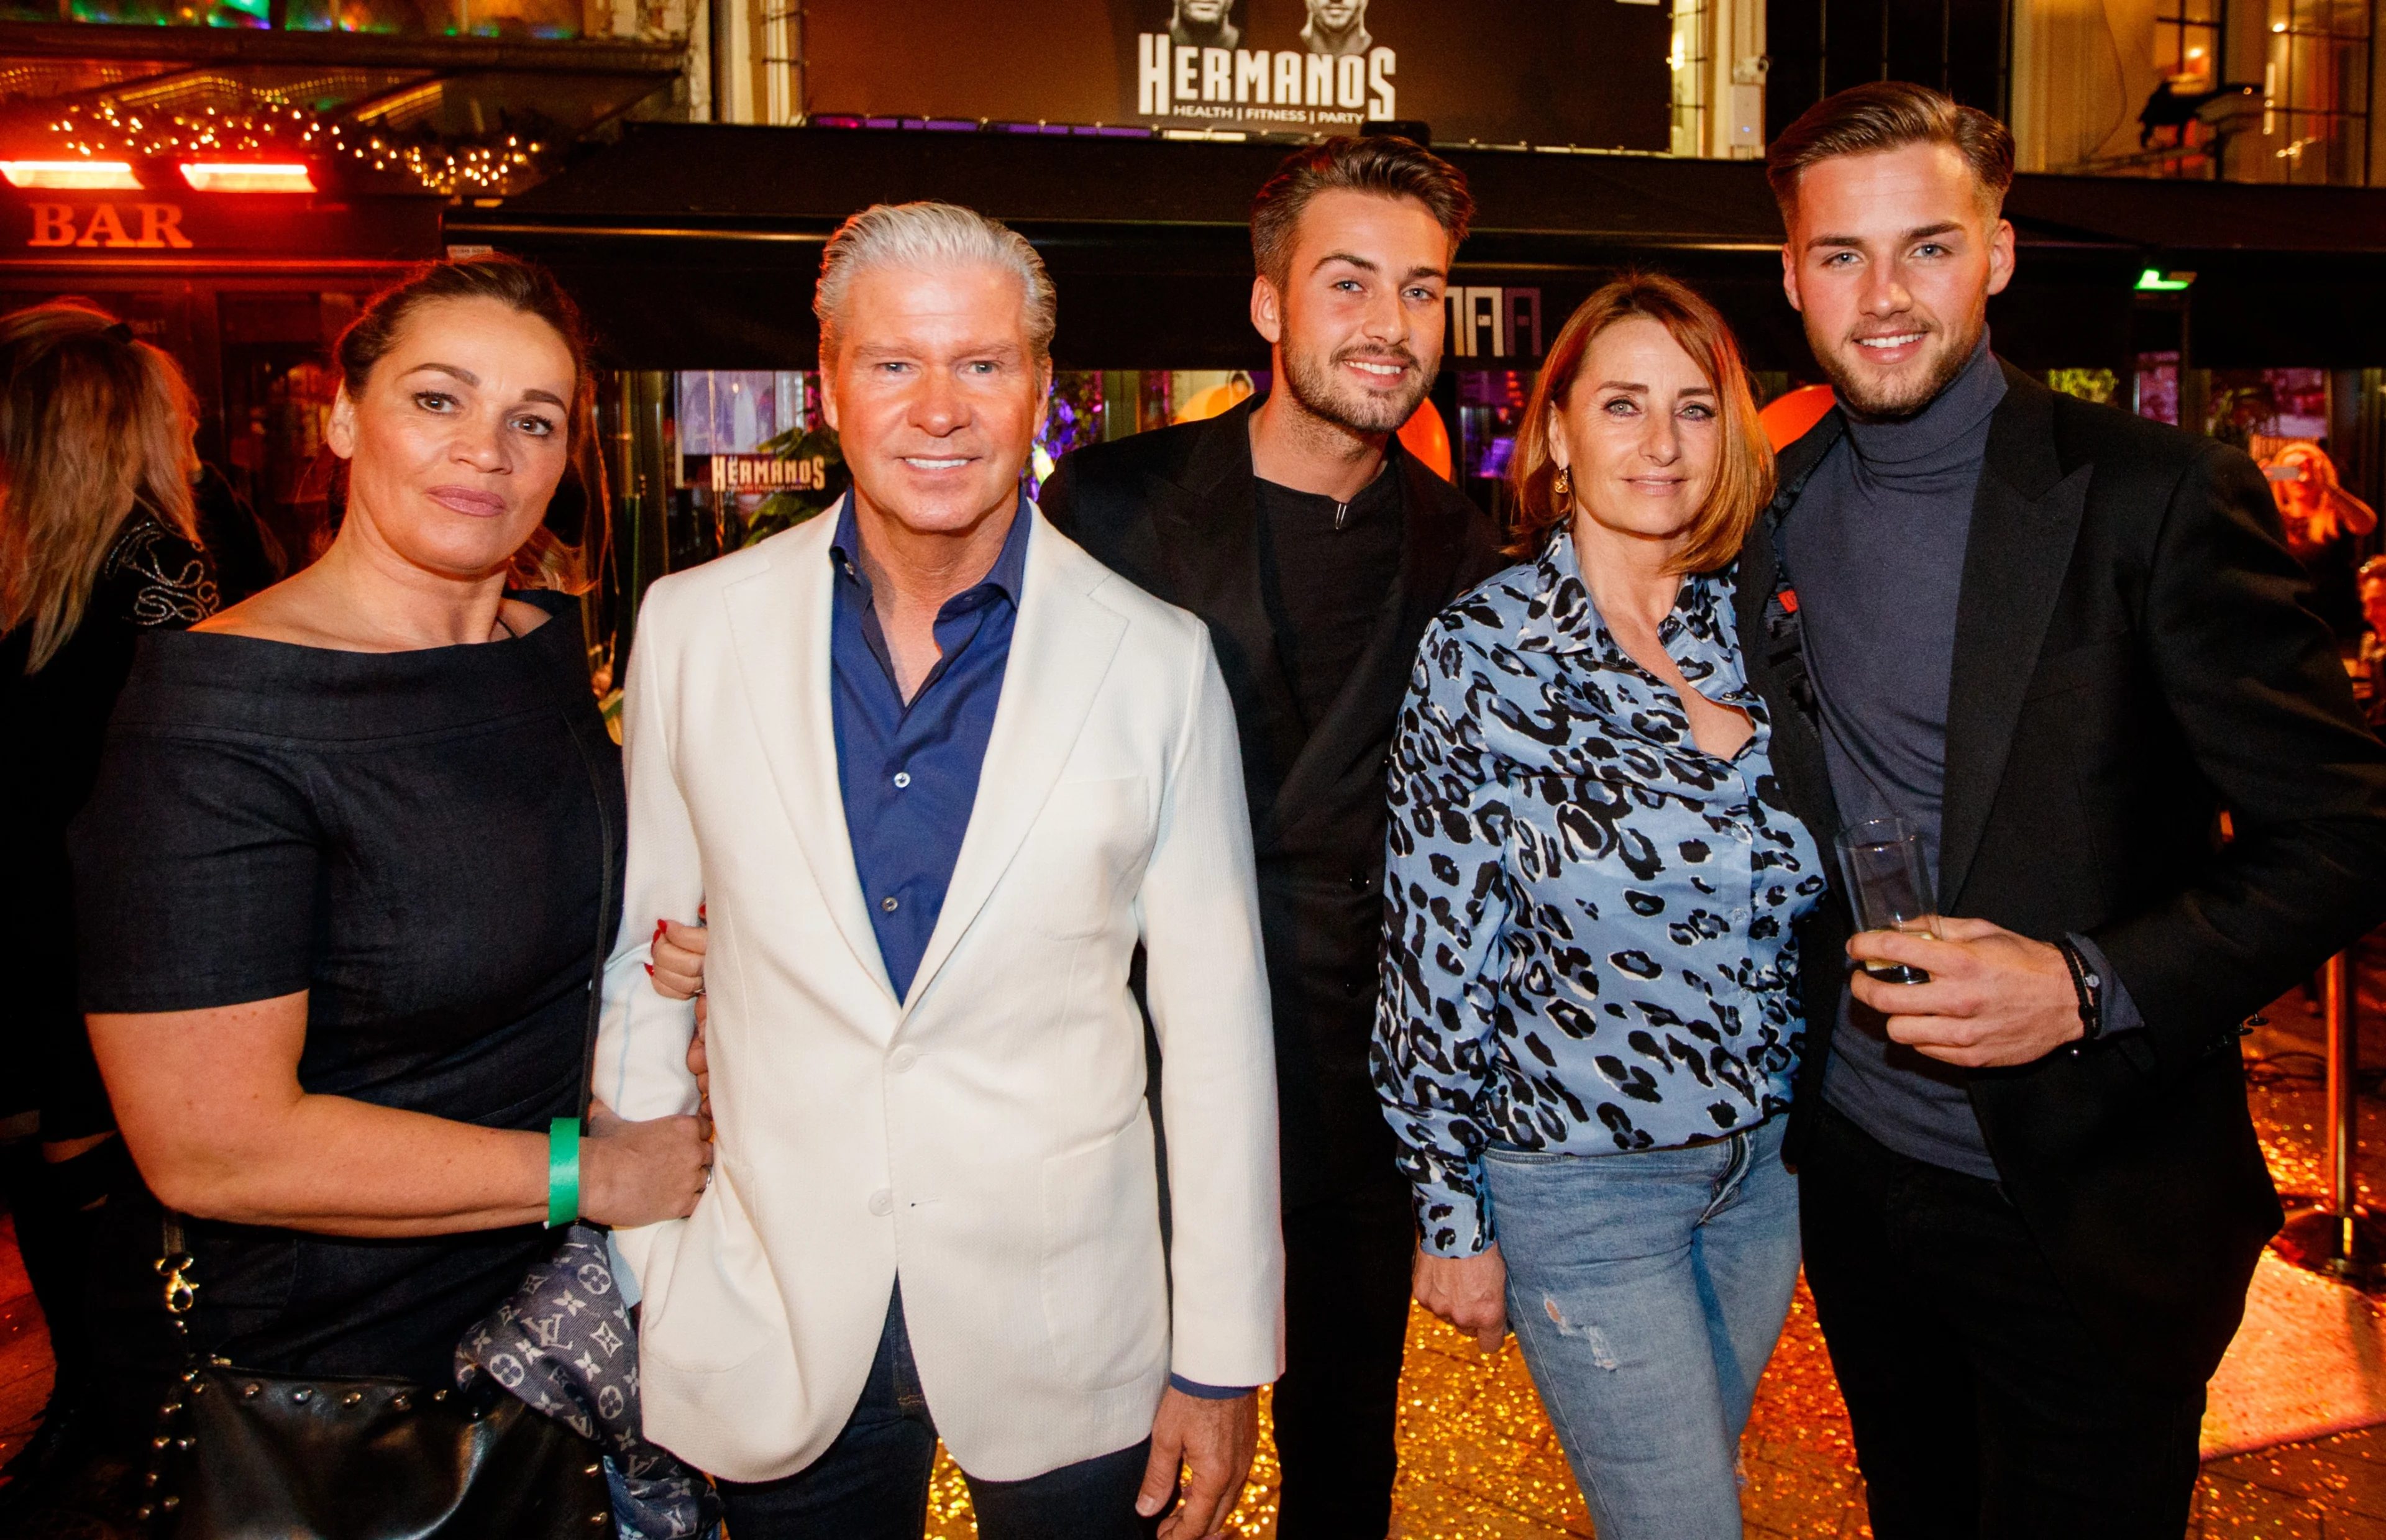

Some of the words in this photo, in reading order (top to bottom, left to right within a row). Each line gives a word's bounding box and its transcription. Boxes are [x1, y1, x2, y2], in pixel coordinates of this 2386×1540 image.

[1138, 33, 1396, 121] HERMANOS
[1174, 105, 1233, 119] HEALTH
[1246, 108, 1306, 122] FITNESS
[1318, 111, 1365, 124] PARTY
[27, 203, 193, 247] BAR
[711, 455, 825, 491] HERMANOS
